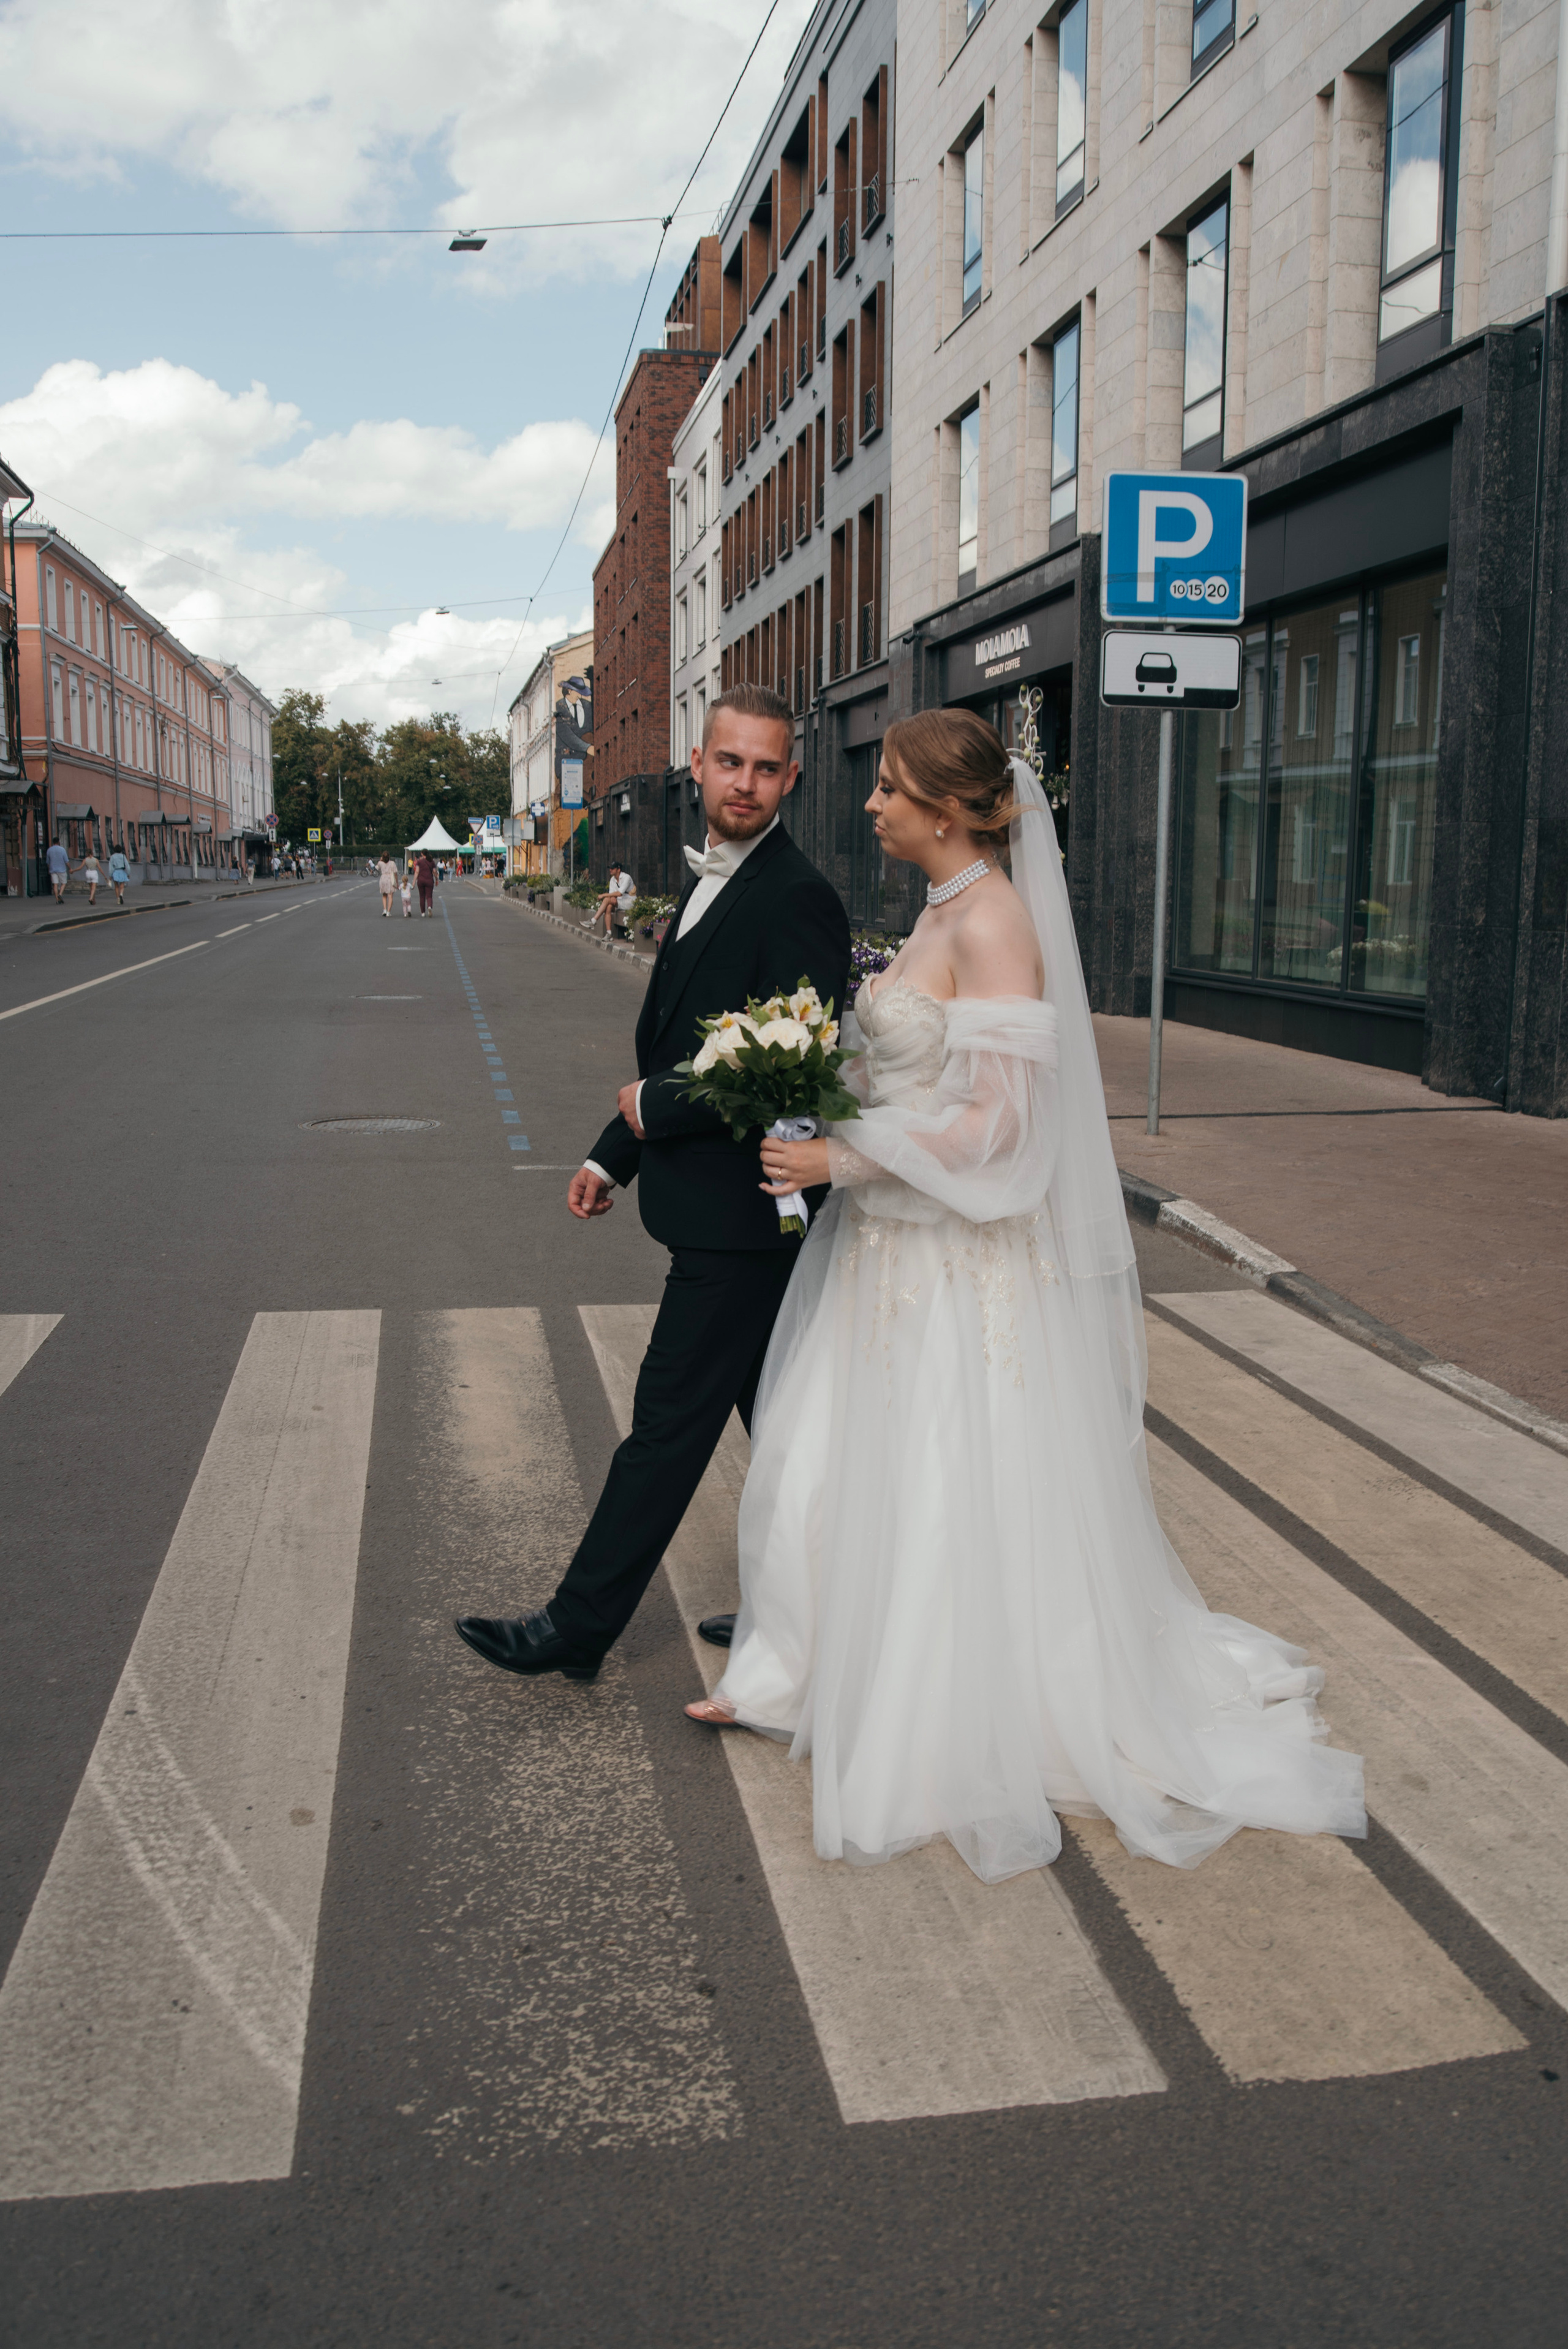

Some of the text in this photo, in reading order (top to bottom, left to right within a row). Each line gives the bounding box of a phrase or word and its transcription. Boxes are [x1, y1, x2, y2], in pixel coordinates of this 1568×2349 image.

[1137, 490, 1213, 603] P
[1173, 584, 1227, 598] 10 15 20
[985, 656, 1020, 679] SPECIALTY COFFEE
[489, 817, 497, 828] P
